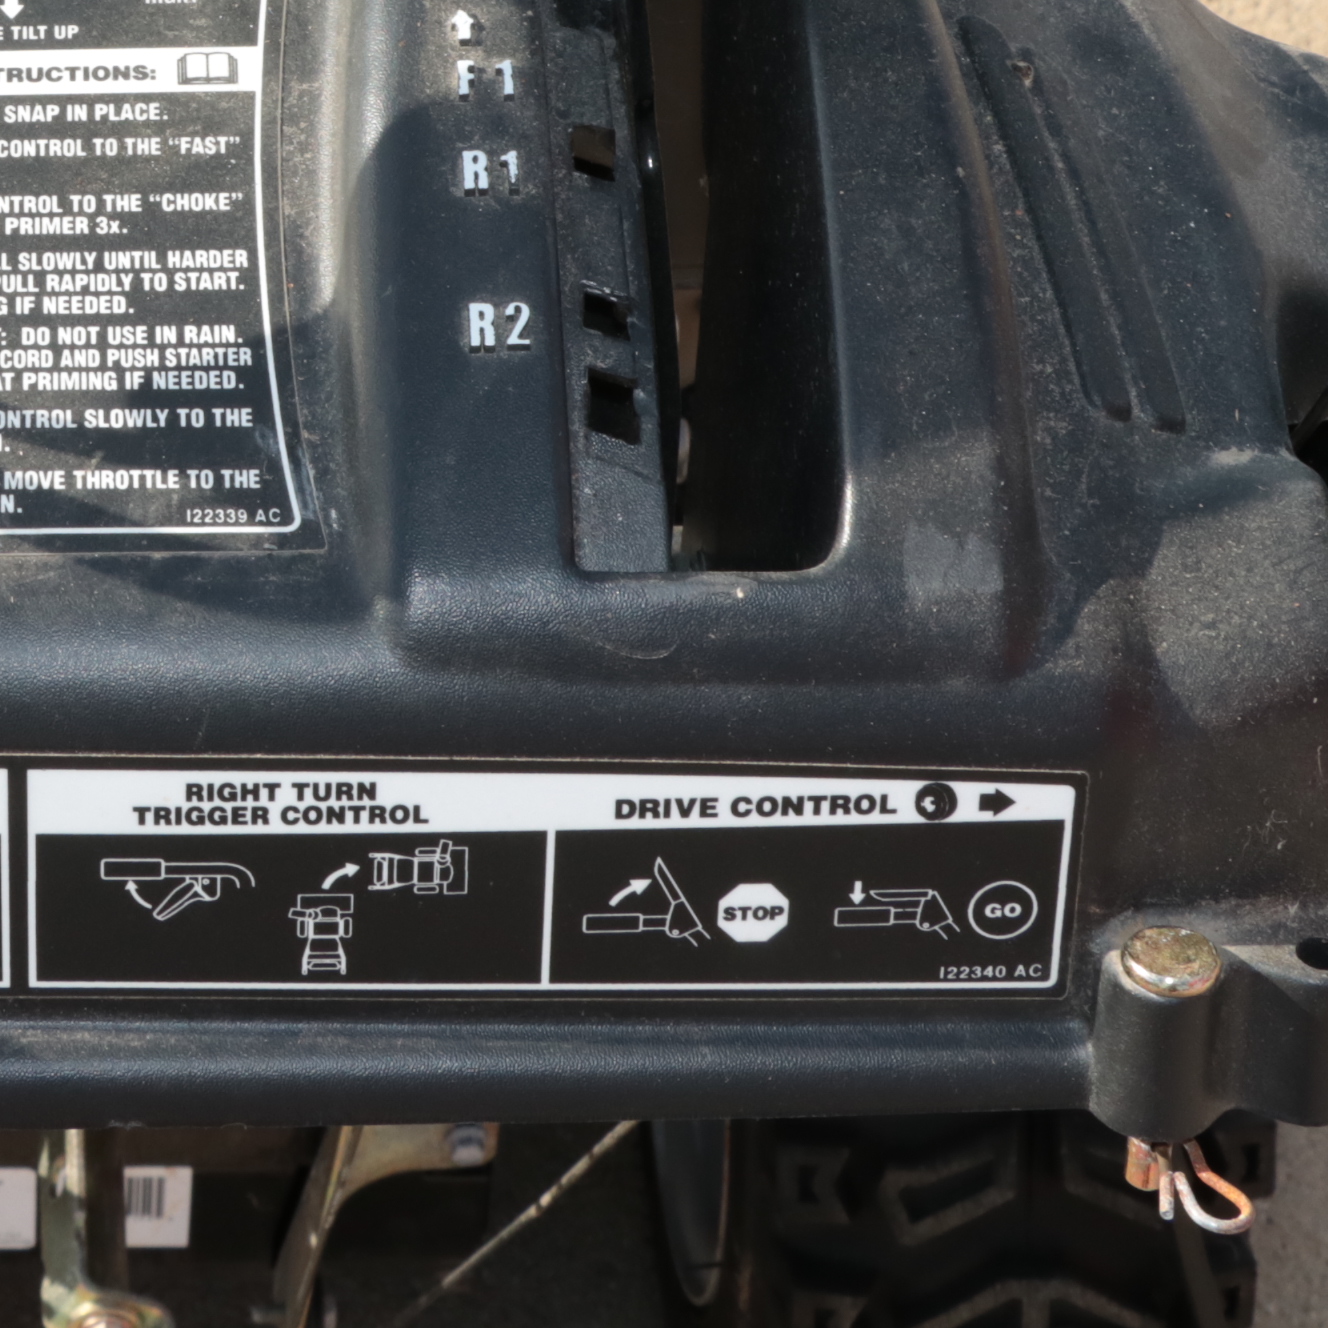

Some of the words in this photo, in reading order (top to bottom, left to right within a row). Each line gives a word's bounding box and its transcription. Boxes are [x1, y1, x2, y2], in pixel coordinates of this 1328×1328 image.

[11, 26, 47, 40] TILT
[54, 25, 79, 39] UP
[4, 104, 59, 123] SNAP
[67, 104, 87, 121] IN
[95, 103, 168, 121] PLACE.
[93, 138, 117, 156] TO
[125, 138, 161, 155] THE
[70, 195, 96, 213] TO
[103, 194, 142, 212] THE
[5, 217, 89, 235] PRIMER
[96, 216, 127, 234] 3x.
[18, 252, 96, 271] SLOWLY
[104, 251, 161, 270] UNTIL
[168, 250, 248, 268] HARDER
[46, 273, 133, 292] RAPIDLY
[140, 273, 167, 291] TO
[174, 272, 244, 291] START.
[16, 296, 35, 314] IF
[43, 295, 134, 314] NEEDED.
[22, 327, 50, 345] DO
[58, 326, 100, 345] NOT
[108, 326, 148, 345] USE
[155, 326, 176, 344] IN
[184, 325, 243, 343] RAIN.
[0, 349, 53, 368] CORD
[60, 349, 100, 367] AND
[107, 348, 159, 368] PUSH
[165, 347, 252, 367] STARTER
[23, 371, 117, 391] PRIMING
[125, 371, 144, 390] IF
[153, 371, 244, 389] NEEDED.
[84, 409, 169, 428] SLOWLY
[177, 408, 204, 427] TO
[212, 408, 253, 427] THE
[4, 470, 65, 490] MOVE
[73, 470, 180, 489] THROTTLE
[187, 470, 213, 489] TO
[221, 469, 260, 488] THE
[255, 508, 280, 522] AC
[186, 783, 281, 802] RIGHT
[292, 782, 376, 802] TURN
[133, 806, 269, 826] TRIGGER
[281, 805, 429, 825] CONTROL
[615, 798, 718, 819] DRIVE
[731, 794, 897, 817] CONTROL
[723, 906, 784, 921] STOP
[985, 903, 1021, 917] GO
[1015, 964, 1042, 976] AC
